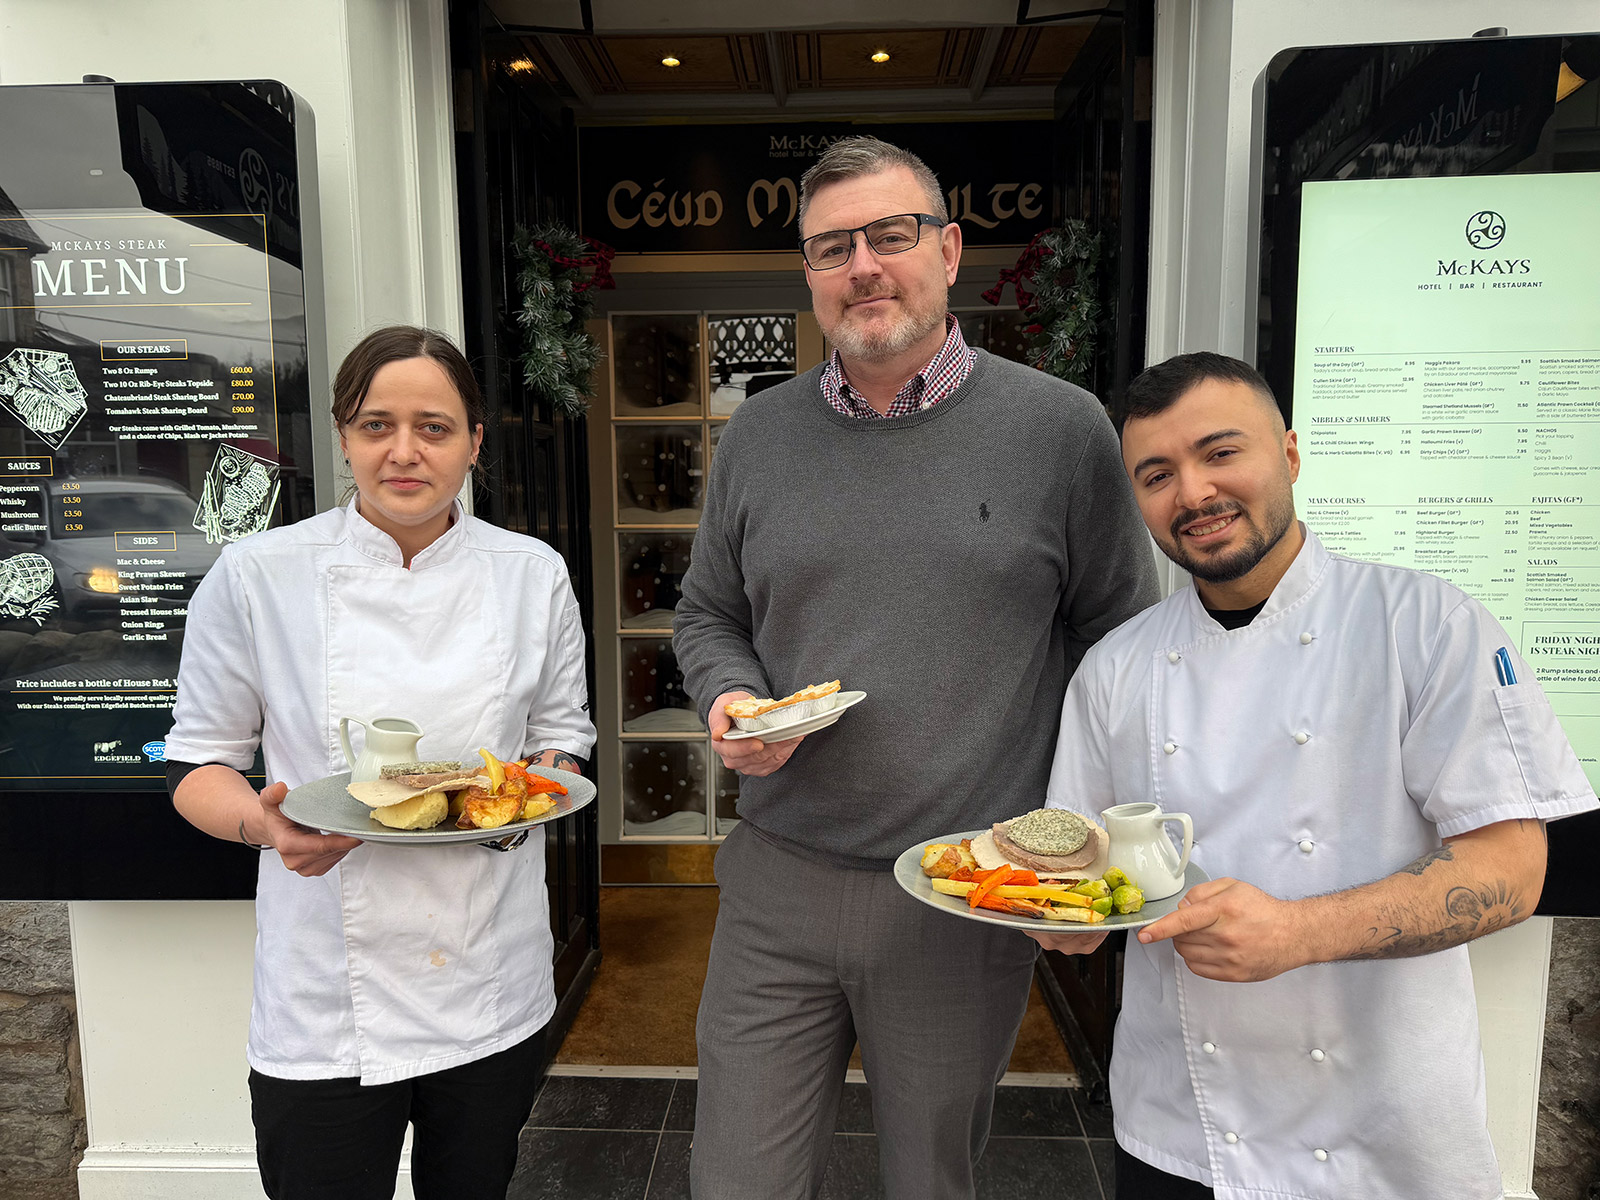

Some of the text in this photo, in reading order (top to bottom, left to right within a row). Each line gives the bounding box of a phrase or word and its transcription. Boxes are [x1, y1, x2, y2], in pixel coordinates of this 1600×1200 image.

[768, 134, 846, 150] McKAY
[51, 239, 167, 251] MCKAYS STEAK
[1436, 259, 1531, 276] McKAYS
[32, 257, 188, 297] MENU
[1492, 281, 1543, 289] RESTAURANT
[117, 345, 171, 354] OUR STEAKS
[134, 367, 158, 375] Rumps
[139, 381, 164, 389] Rib-Eye
[166, 380, 186, 388] Steaks
[187, 380, 214, 388] Topside
[104, 394, 152, 402] Chateaubriand
[172, 394, 198, 402] Sharing
[161, 407, 187, 416] Sharing
[0, 485, 39, 493] Peppercorn
[0, 499, 26, 507] Whisky
[133, 537, 158, 545] SIDES
[118, 571, 135, 579] King
[144, 621, 164, 629] Rings
[1536, 636, 1572, 644] FRIDAY
[16, 680, 39, 688] Price
[41, 679, 77, 687] includes
[85, 679, 111, 687] bottle
[113, 679, 122, 687] of
[123, 679, 151, 687] House
[152, 679, 172, 688] Red,
[64, 695, 86, 703] proudly
